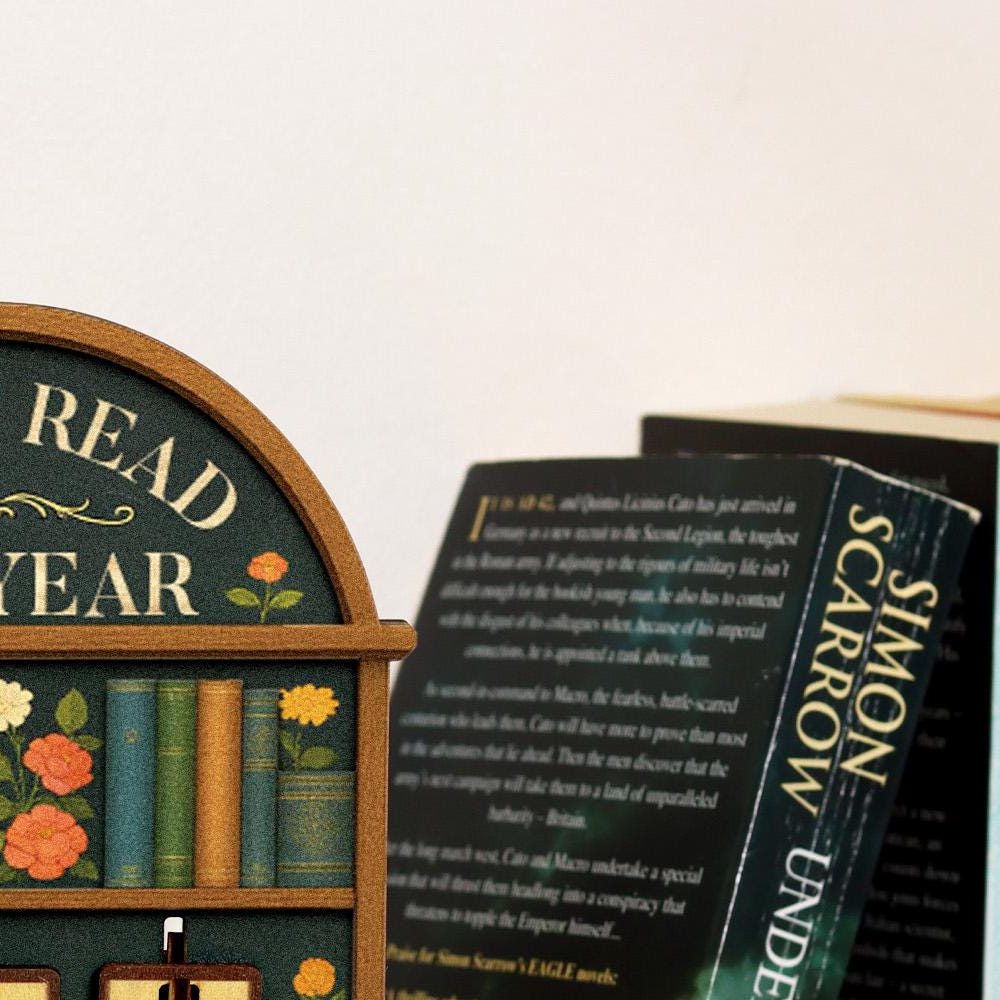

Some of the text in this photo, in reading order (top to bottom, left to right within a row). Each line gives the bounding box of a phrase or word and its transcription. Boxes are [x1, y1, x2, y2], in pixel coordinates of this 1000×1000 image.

[23, 382, 238, 531] READ
[727, 527, 748, 543] the
[748, 528, 800, 549] toughest
[780, 504, 893, 817] SCARROW
[839, 569, 938, 787] SIMON
[687, 726, 716, 743] than
[715, 731, 748, 746] most
[683, 758, 709, 775] that
[708, 759, 730, 777] the
[659, 867, 705, 886] special
[661, 897, 687, 915] that
